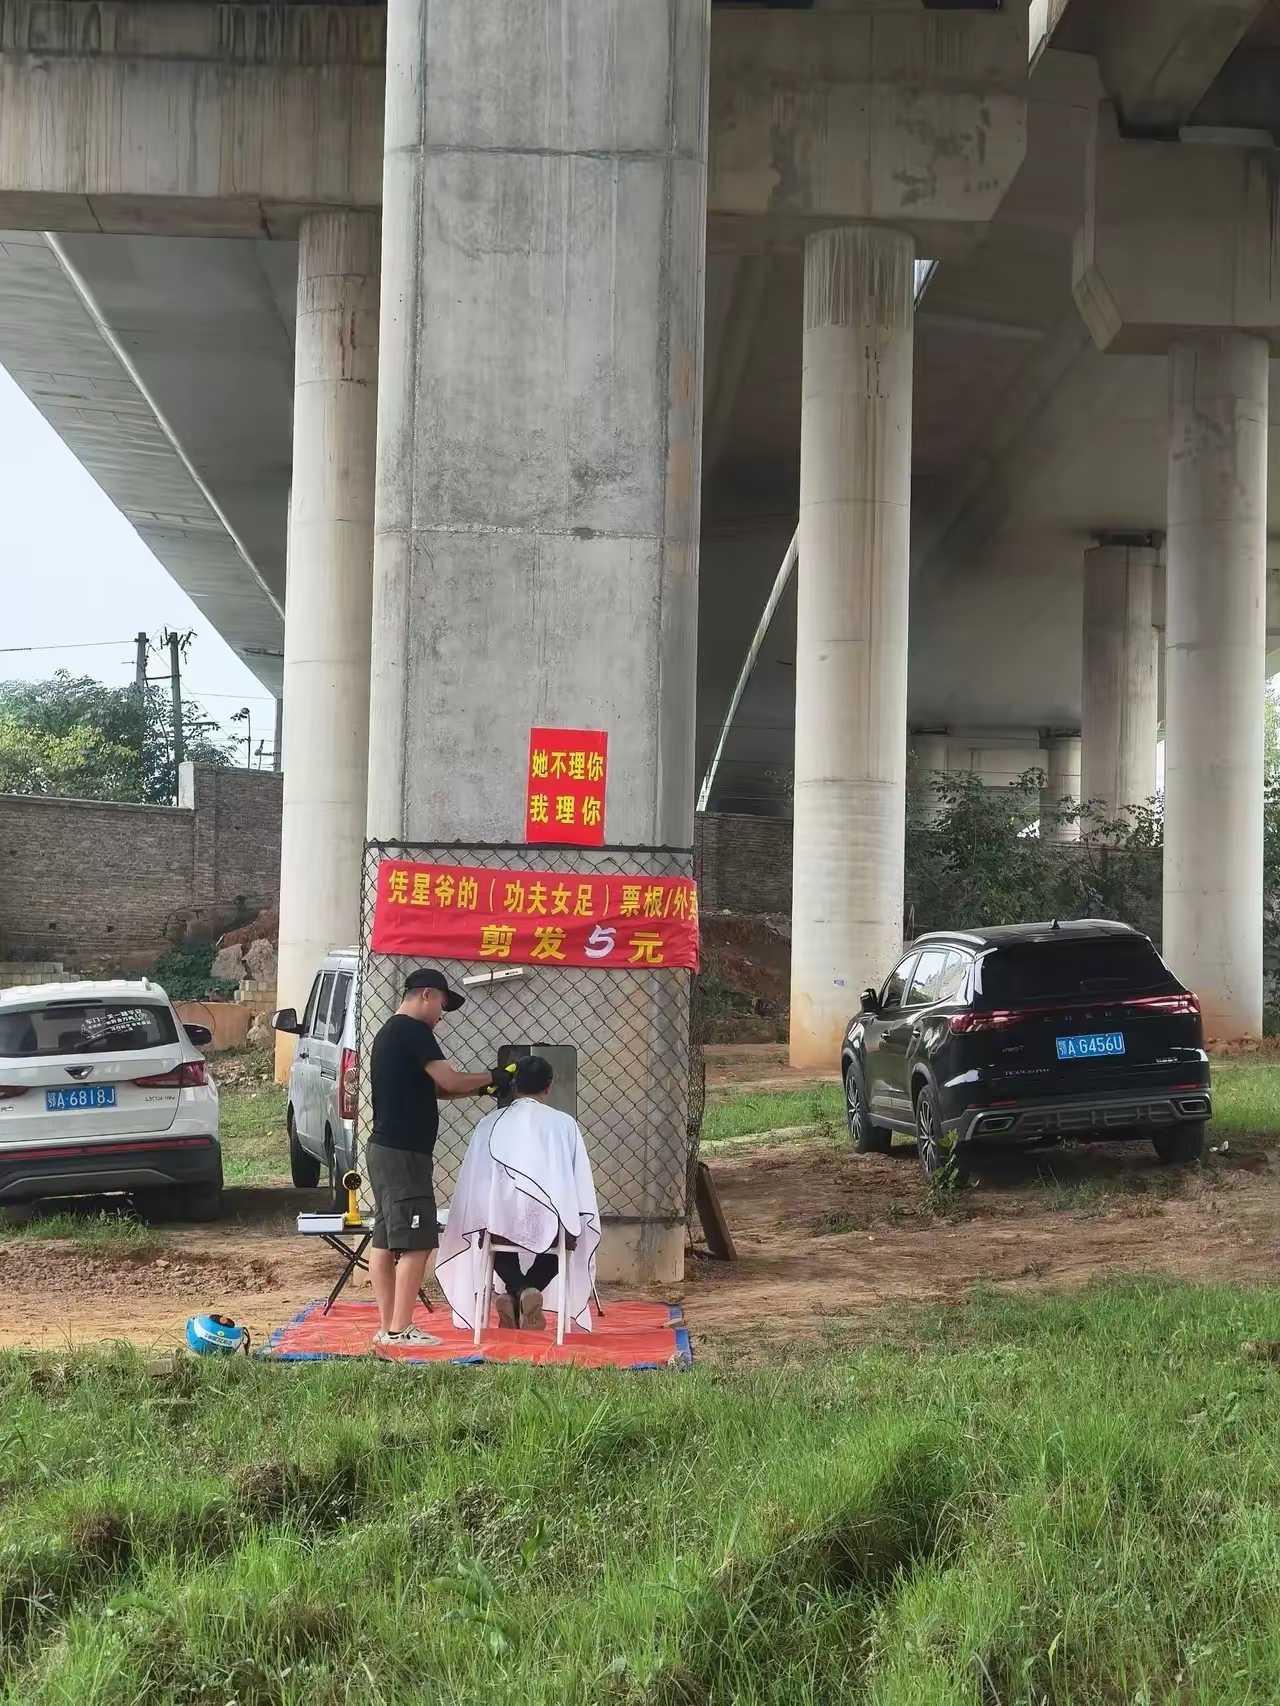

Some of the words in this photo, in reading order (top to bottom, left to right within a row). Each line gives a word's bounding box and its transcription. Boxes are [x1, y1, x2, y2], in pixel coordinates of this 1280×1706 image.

[531, 749, 604, 781] 她不理你
[529, 793, 601, 826] 我理你
[479, 924, 665, 964] 剪发5元
